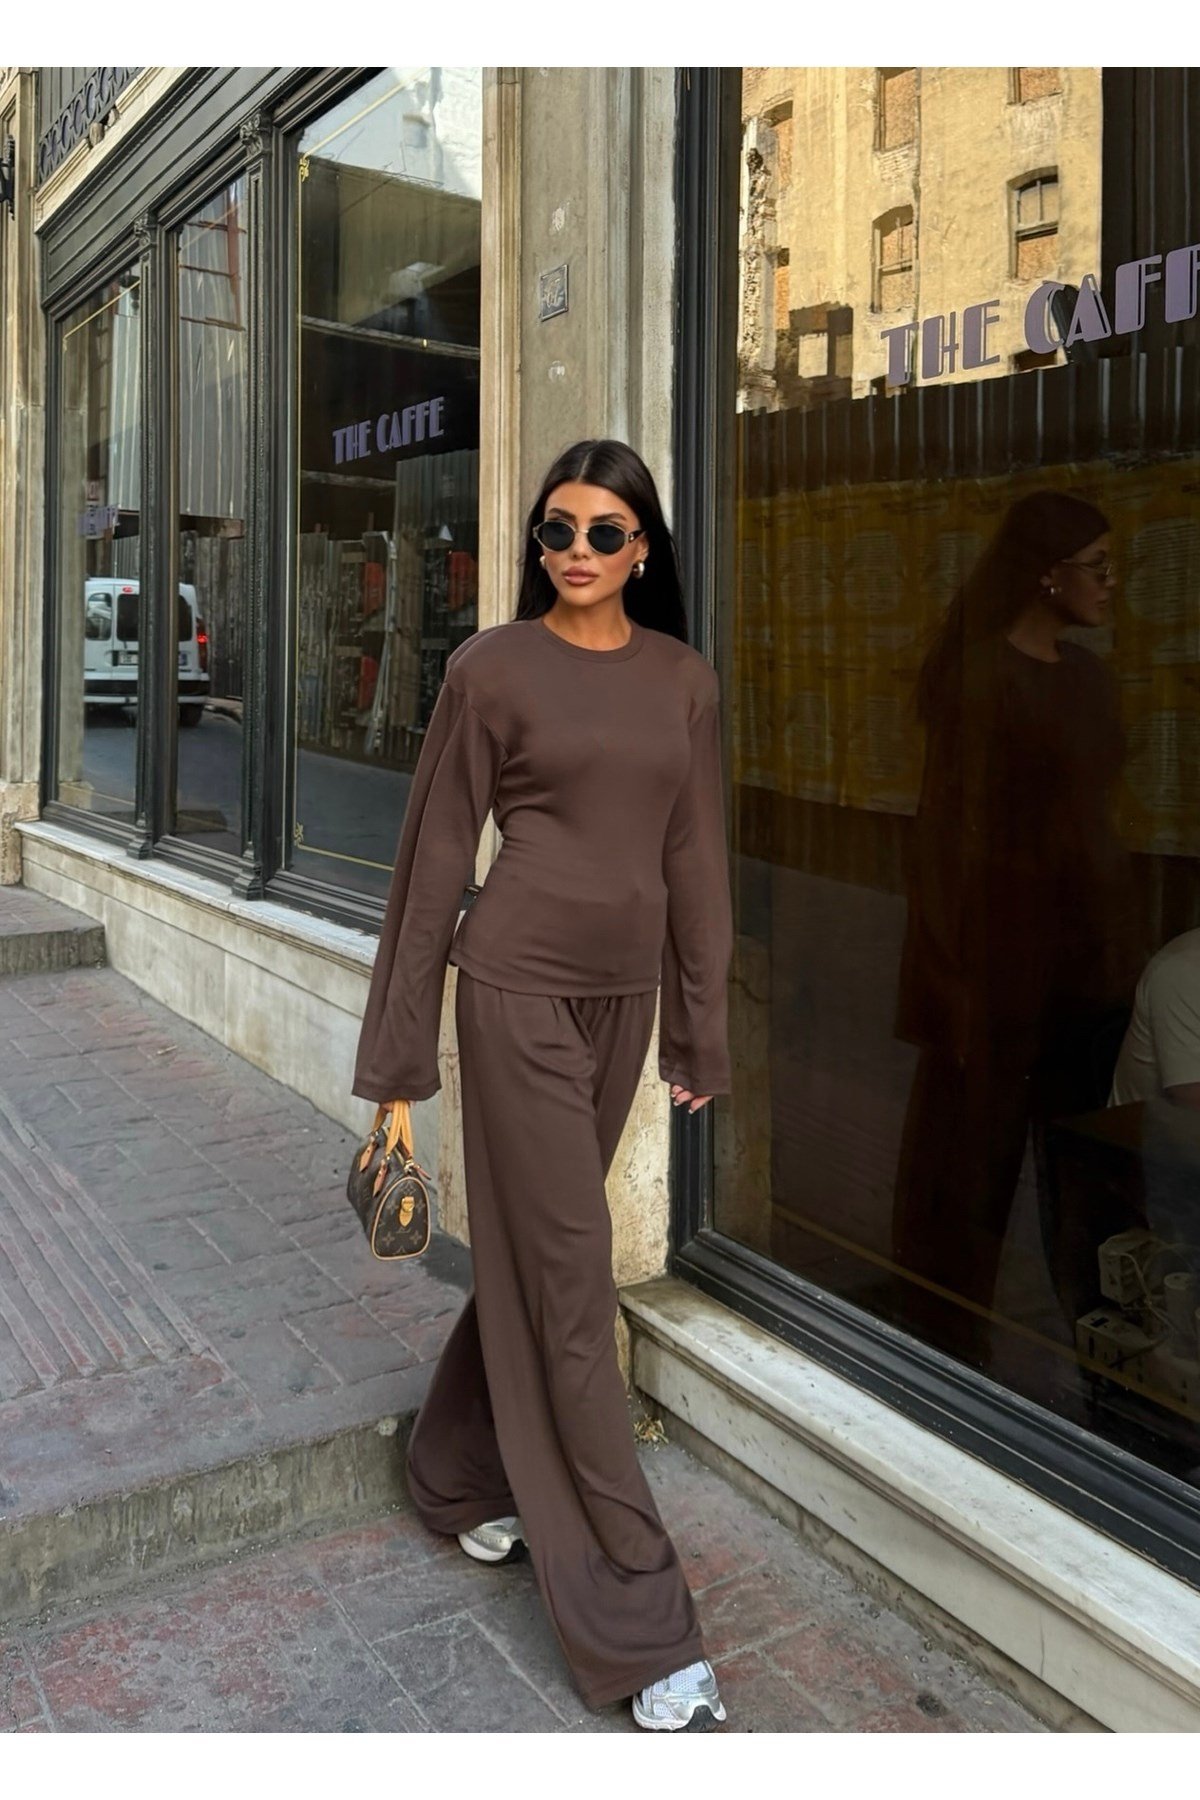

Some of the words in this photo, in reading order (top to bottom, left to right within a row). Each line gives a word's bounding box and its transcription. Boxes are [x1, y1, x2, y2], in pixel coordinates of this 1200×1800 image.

[880, 299, 1000, 388] THE
[332, 420, 371, 465] THE
[376, 396, 445, 453] CAFFE
